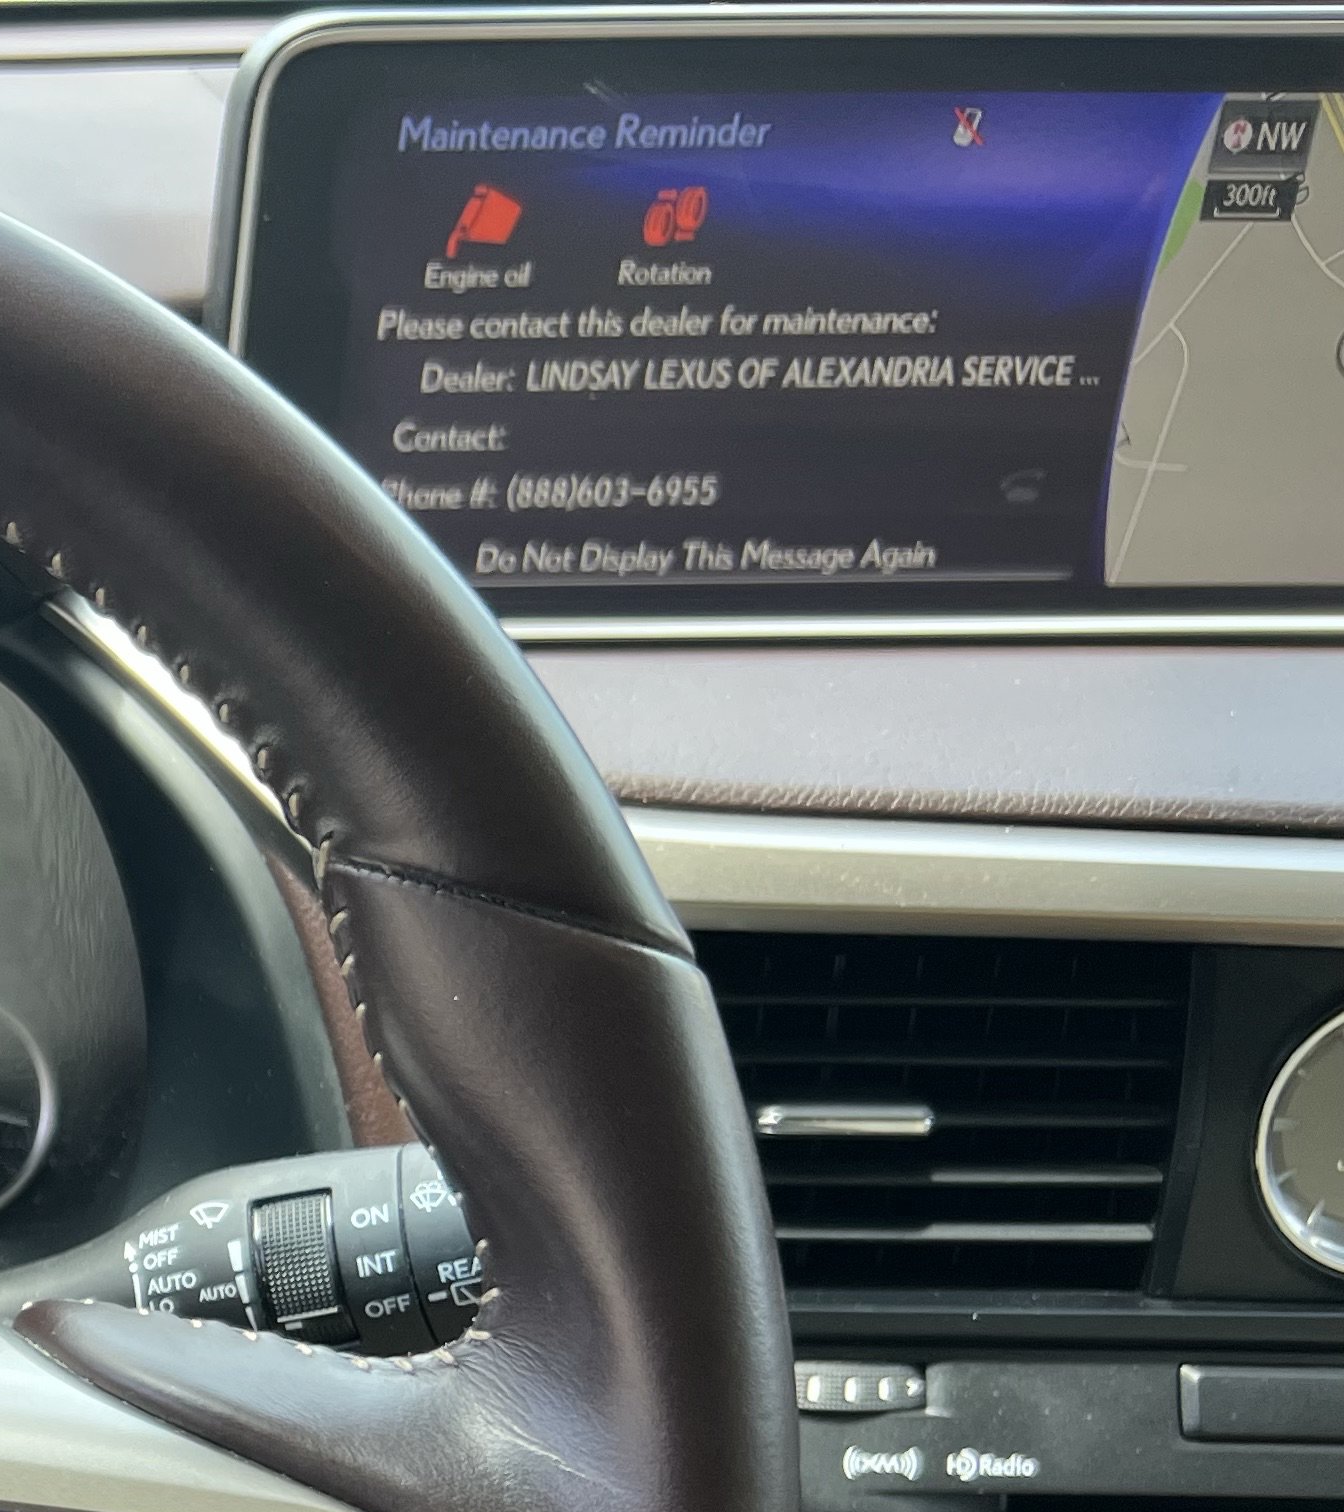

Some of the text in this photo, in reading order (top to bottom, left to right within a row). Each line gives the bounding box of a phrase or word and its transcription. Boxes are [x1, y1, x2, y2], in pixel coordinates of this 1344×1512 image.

[398, 112, 771, 152] Maintenance Reminder
[1257, 121, 1308, 150] NW
[424, 260, 532, 292] Engine oil
[618, 260, 712, 285] Rotation
[377, 304, 939, 341] Please contact this dealer for maintenance:
[420, 361, 516, 393] Dealer:
[526, 359, 640, 392] LINDSAY
[644, 358, 733, 390] LEXUS
[738, 358, 779, 389] OF
[781, 356, 954, 388] ALEXANDRIA
[962, 355, 1076, 386] SERVICE
[393, 420, 507, 452] Contact:
[507, 472, 720, 512] (888)603-6955
[476, 538, 936, 576] Do Not Display This Message Again
[350, 1203, 389, 1229] ON
[139, 1223, 178, 1249] MIST
[143, 1247, 178, 1271] OFF
[355, 1250, 398, 1278] INT
[148, 1271, 197, 1296] AUTO
[199, 1283, 237, 1302] AUTO
[365, 1294, 411, 1319] OFF
[980, 1452, 1040, 1478] Radio
